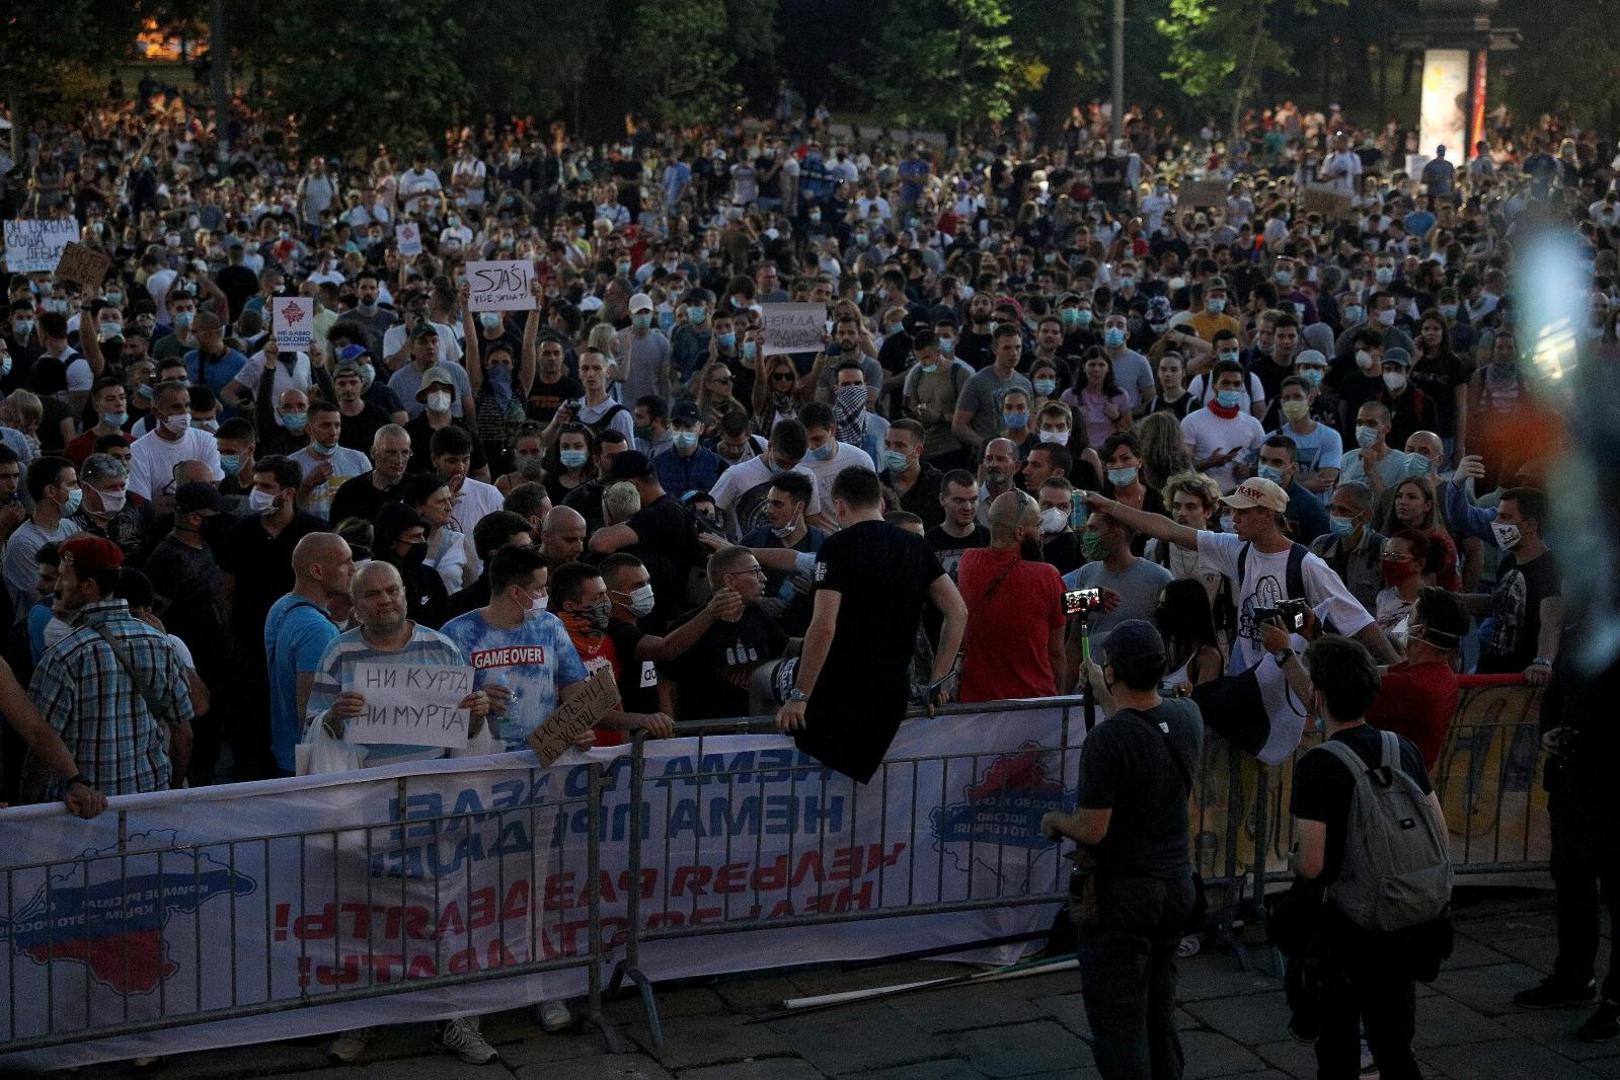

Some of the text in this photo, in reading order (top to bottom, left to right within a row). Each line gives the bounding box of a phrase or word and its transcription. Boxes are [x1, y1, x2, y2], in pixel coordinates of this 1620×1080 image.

[1238, 486, 1266, 499] RAW
[366, 668, 468, 692] НИ КУРТА
[356, 703, 465, 733] НИ МУРТА
